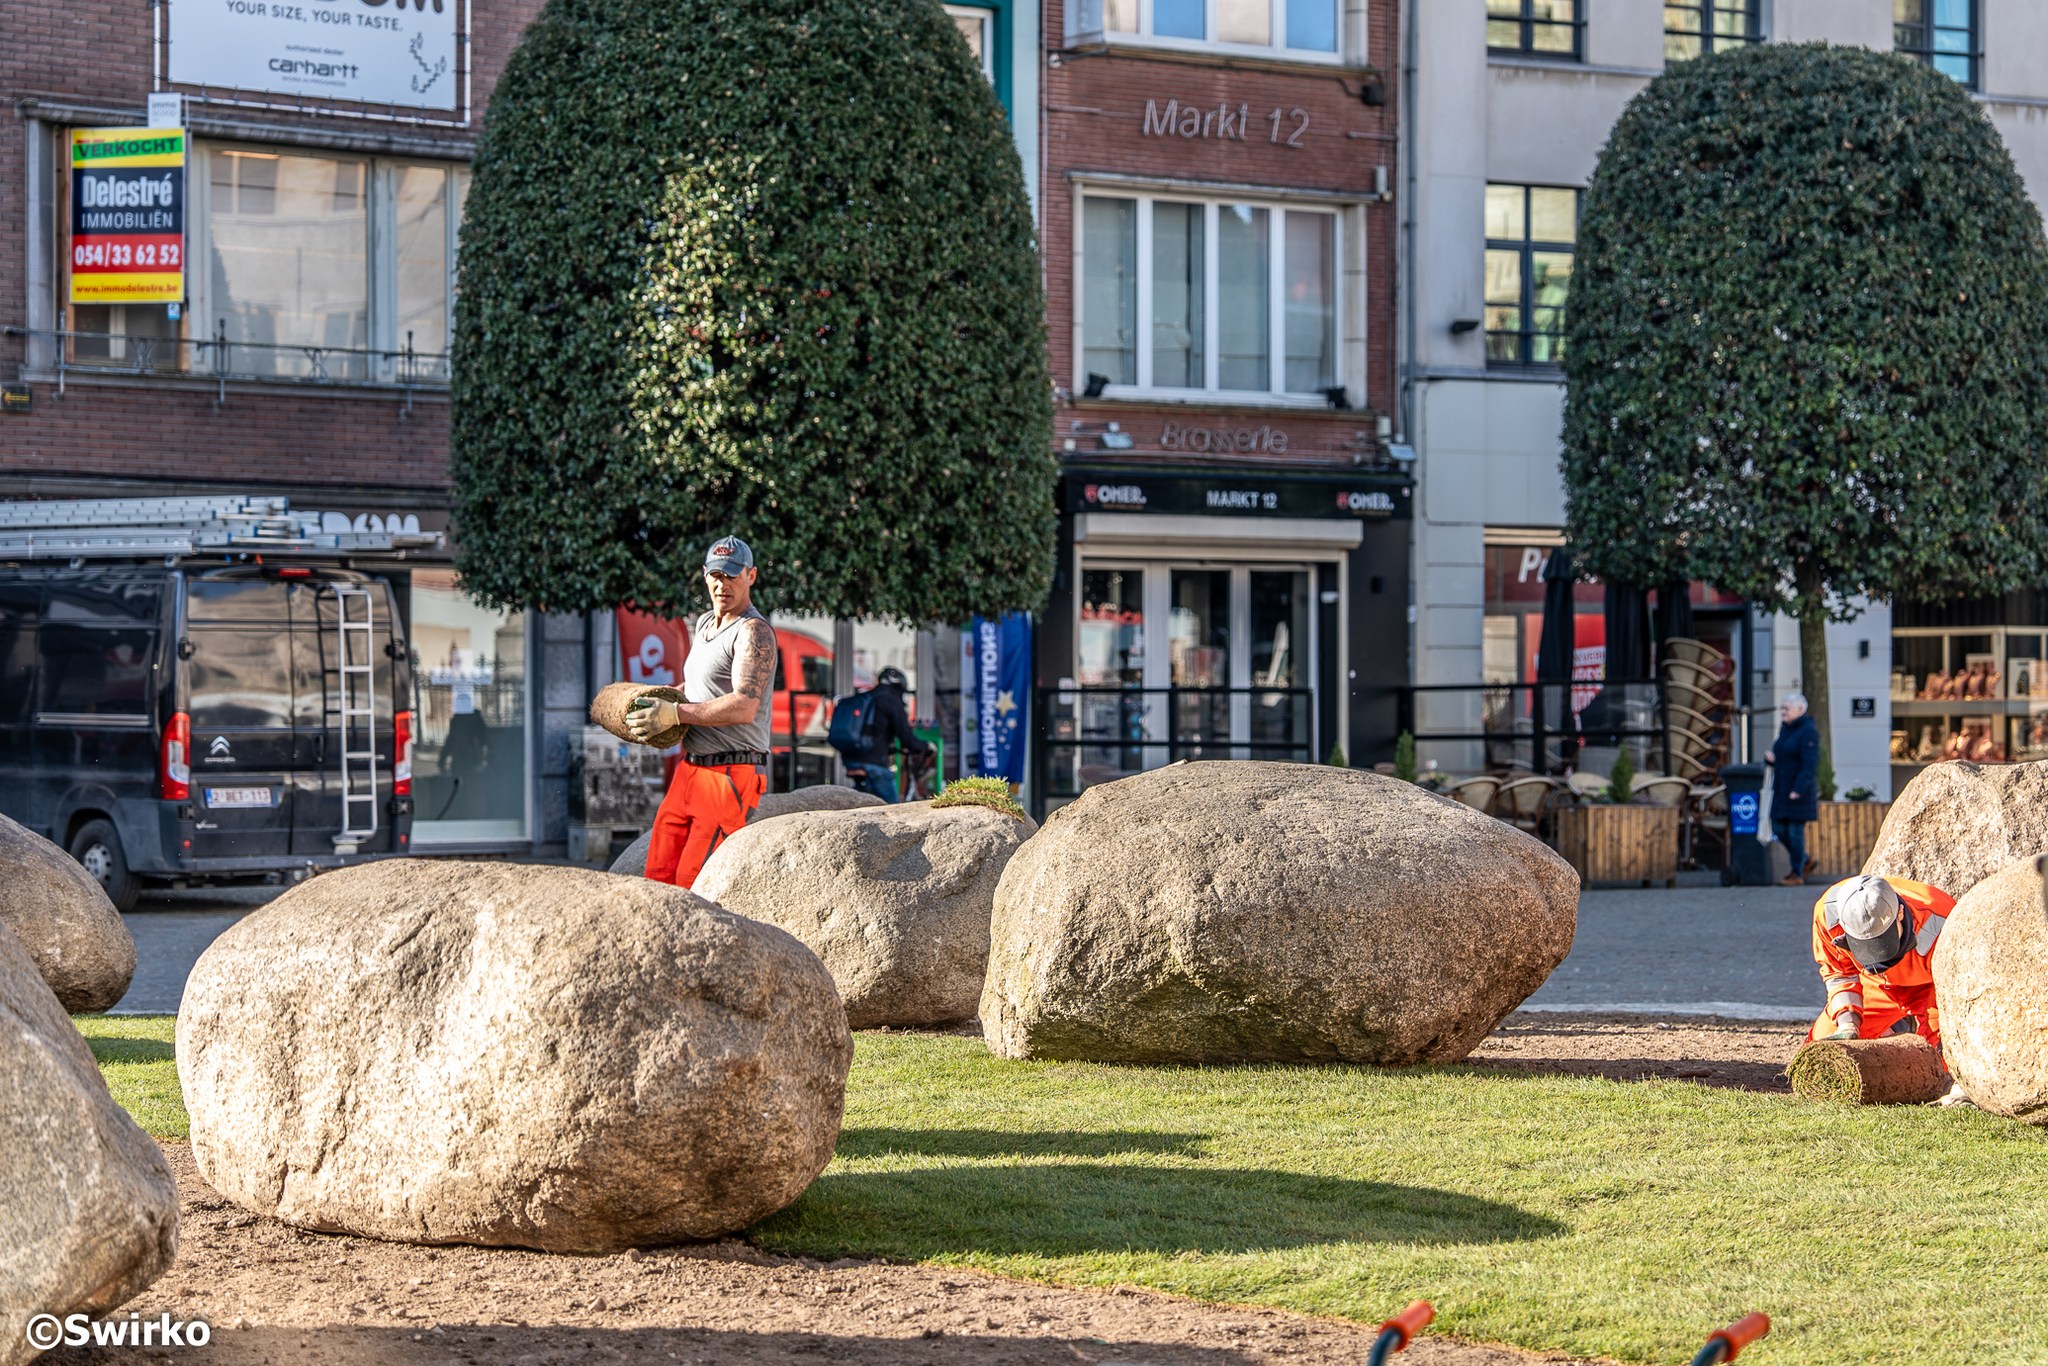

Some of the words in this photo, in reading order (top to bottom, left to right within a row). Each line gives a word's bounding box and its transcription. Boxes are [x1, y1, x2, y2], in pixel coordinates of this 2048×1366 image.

[226, 1, 266, 16] YOUR
[272, 4, 307, 22] SIZE,
[312, 9, 351, 25] YOUR
[356, 14, 403, 32] TASTE.
[269, 58, 358, 79] carhartt
[1142, 98, 1249, 140] Markt
[1266, 107, 1310, 148] 12
[78, 137, 178, 158] VERKOCHT
[82, 172, 173, 207] Delestré
[81, 209, 173, 229] IMMOBILIËN
[75, 242, 132, 267] 054/33
[136, 244, 156, 265] 62
[160, 244, 179, 266] 52
[1160, 420, 1289, 454] Brasserie
[1206, 490, 1259, 508] MARKT
[1261, 492, 1278, 509] 12
